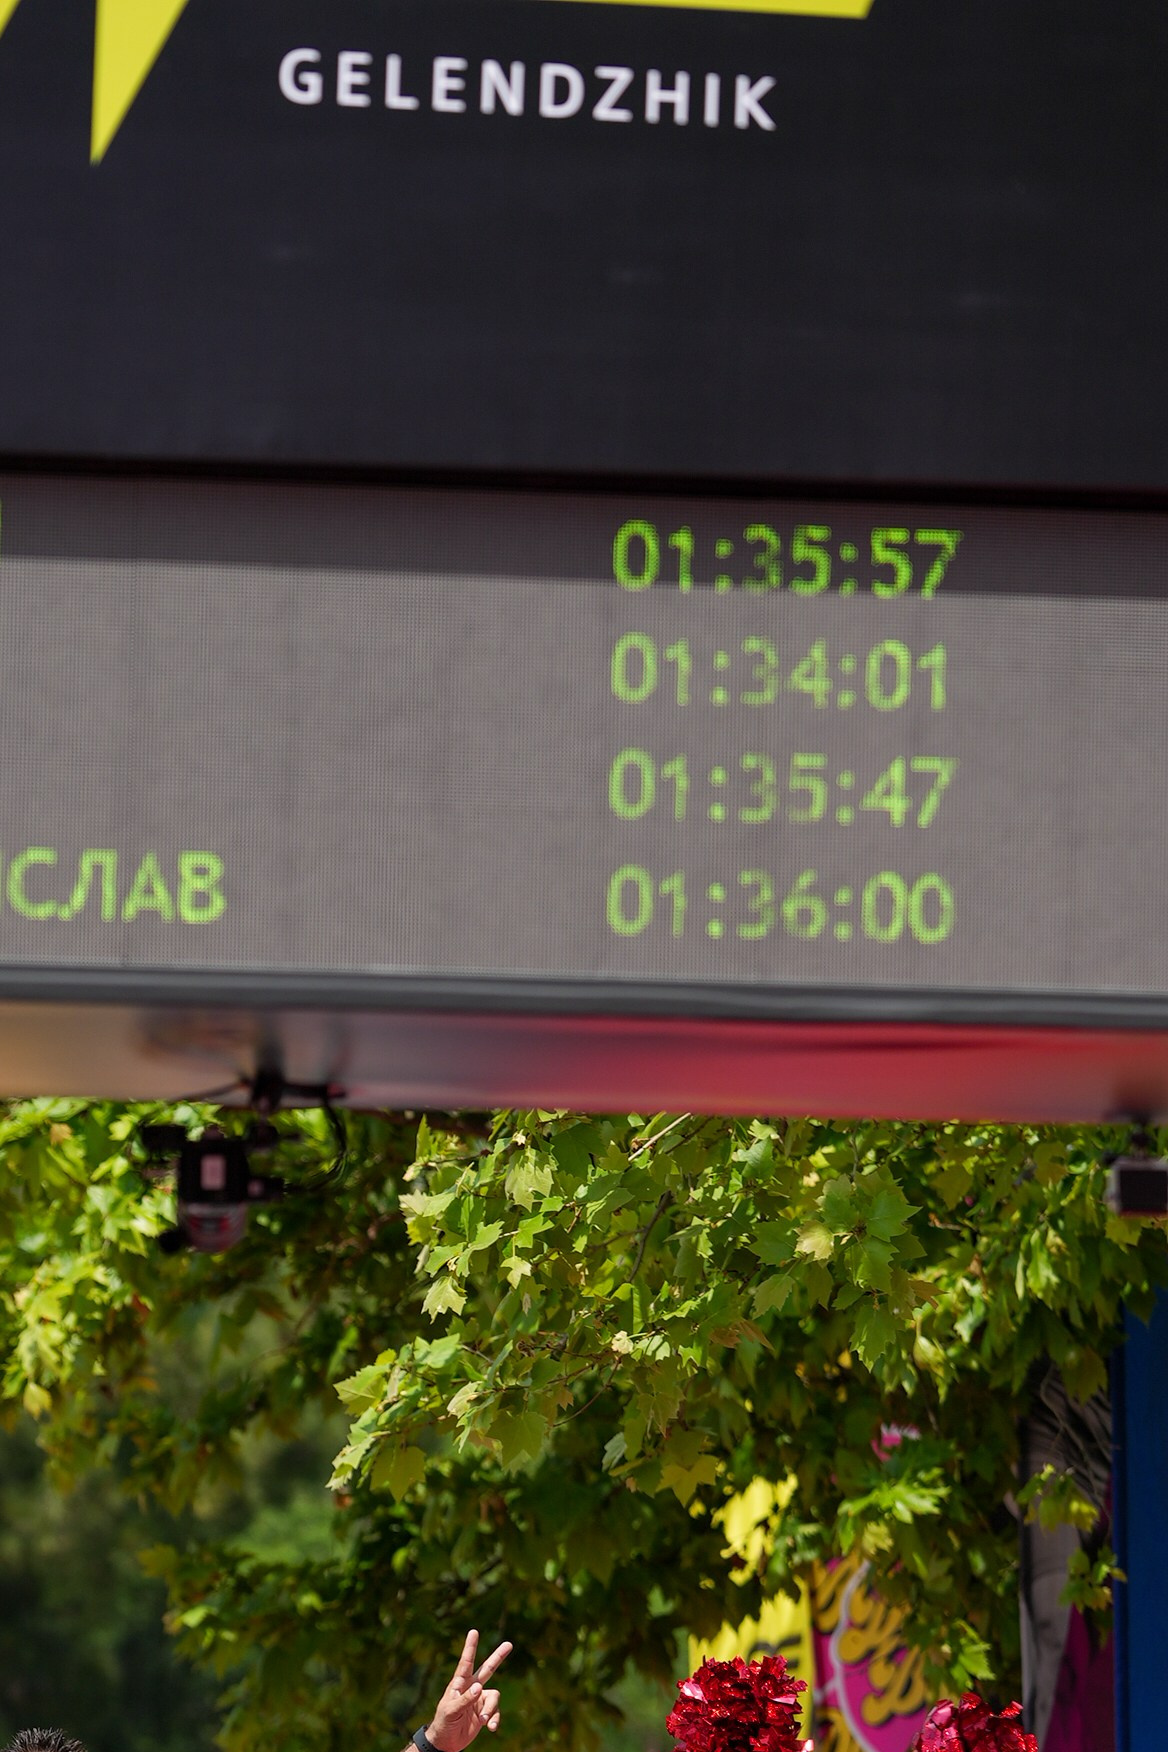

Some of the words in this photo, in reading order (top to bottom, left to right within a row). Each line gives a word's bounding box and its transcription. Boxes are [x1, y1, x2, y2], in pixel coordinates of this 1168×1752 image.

[278, 48, 775, 132] GELENDZHIK
[612, 518, 963, 600] 01:35:57
[611, 632, 949, 710] 01:34:01
[609, 748, 958, 828] 01:35:47
[607, 865, 956, 944] 01:36:00
